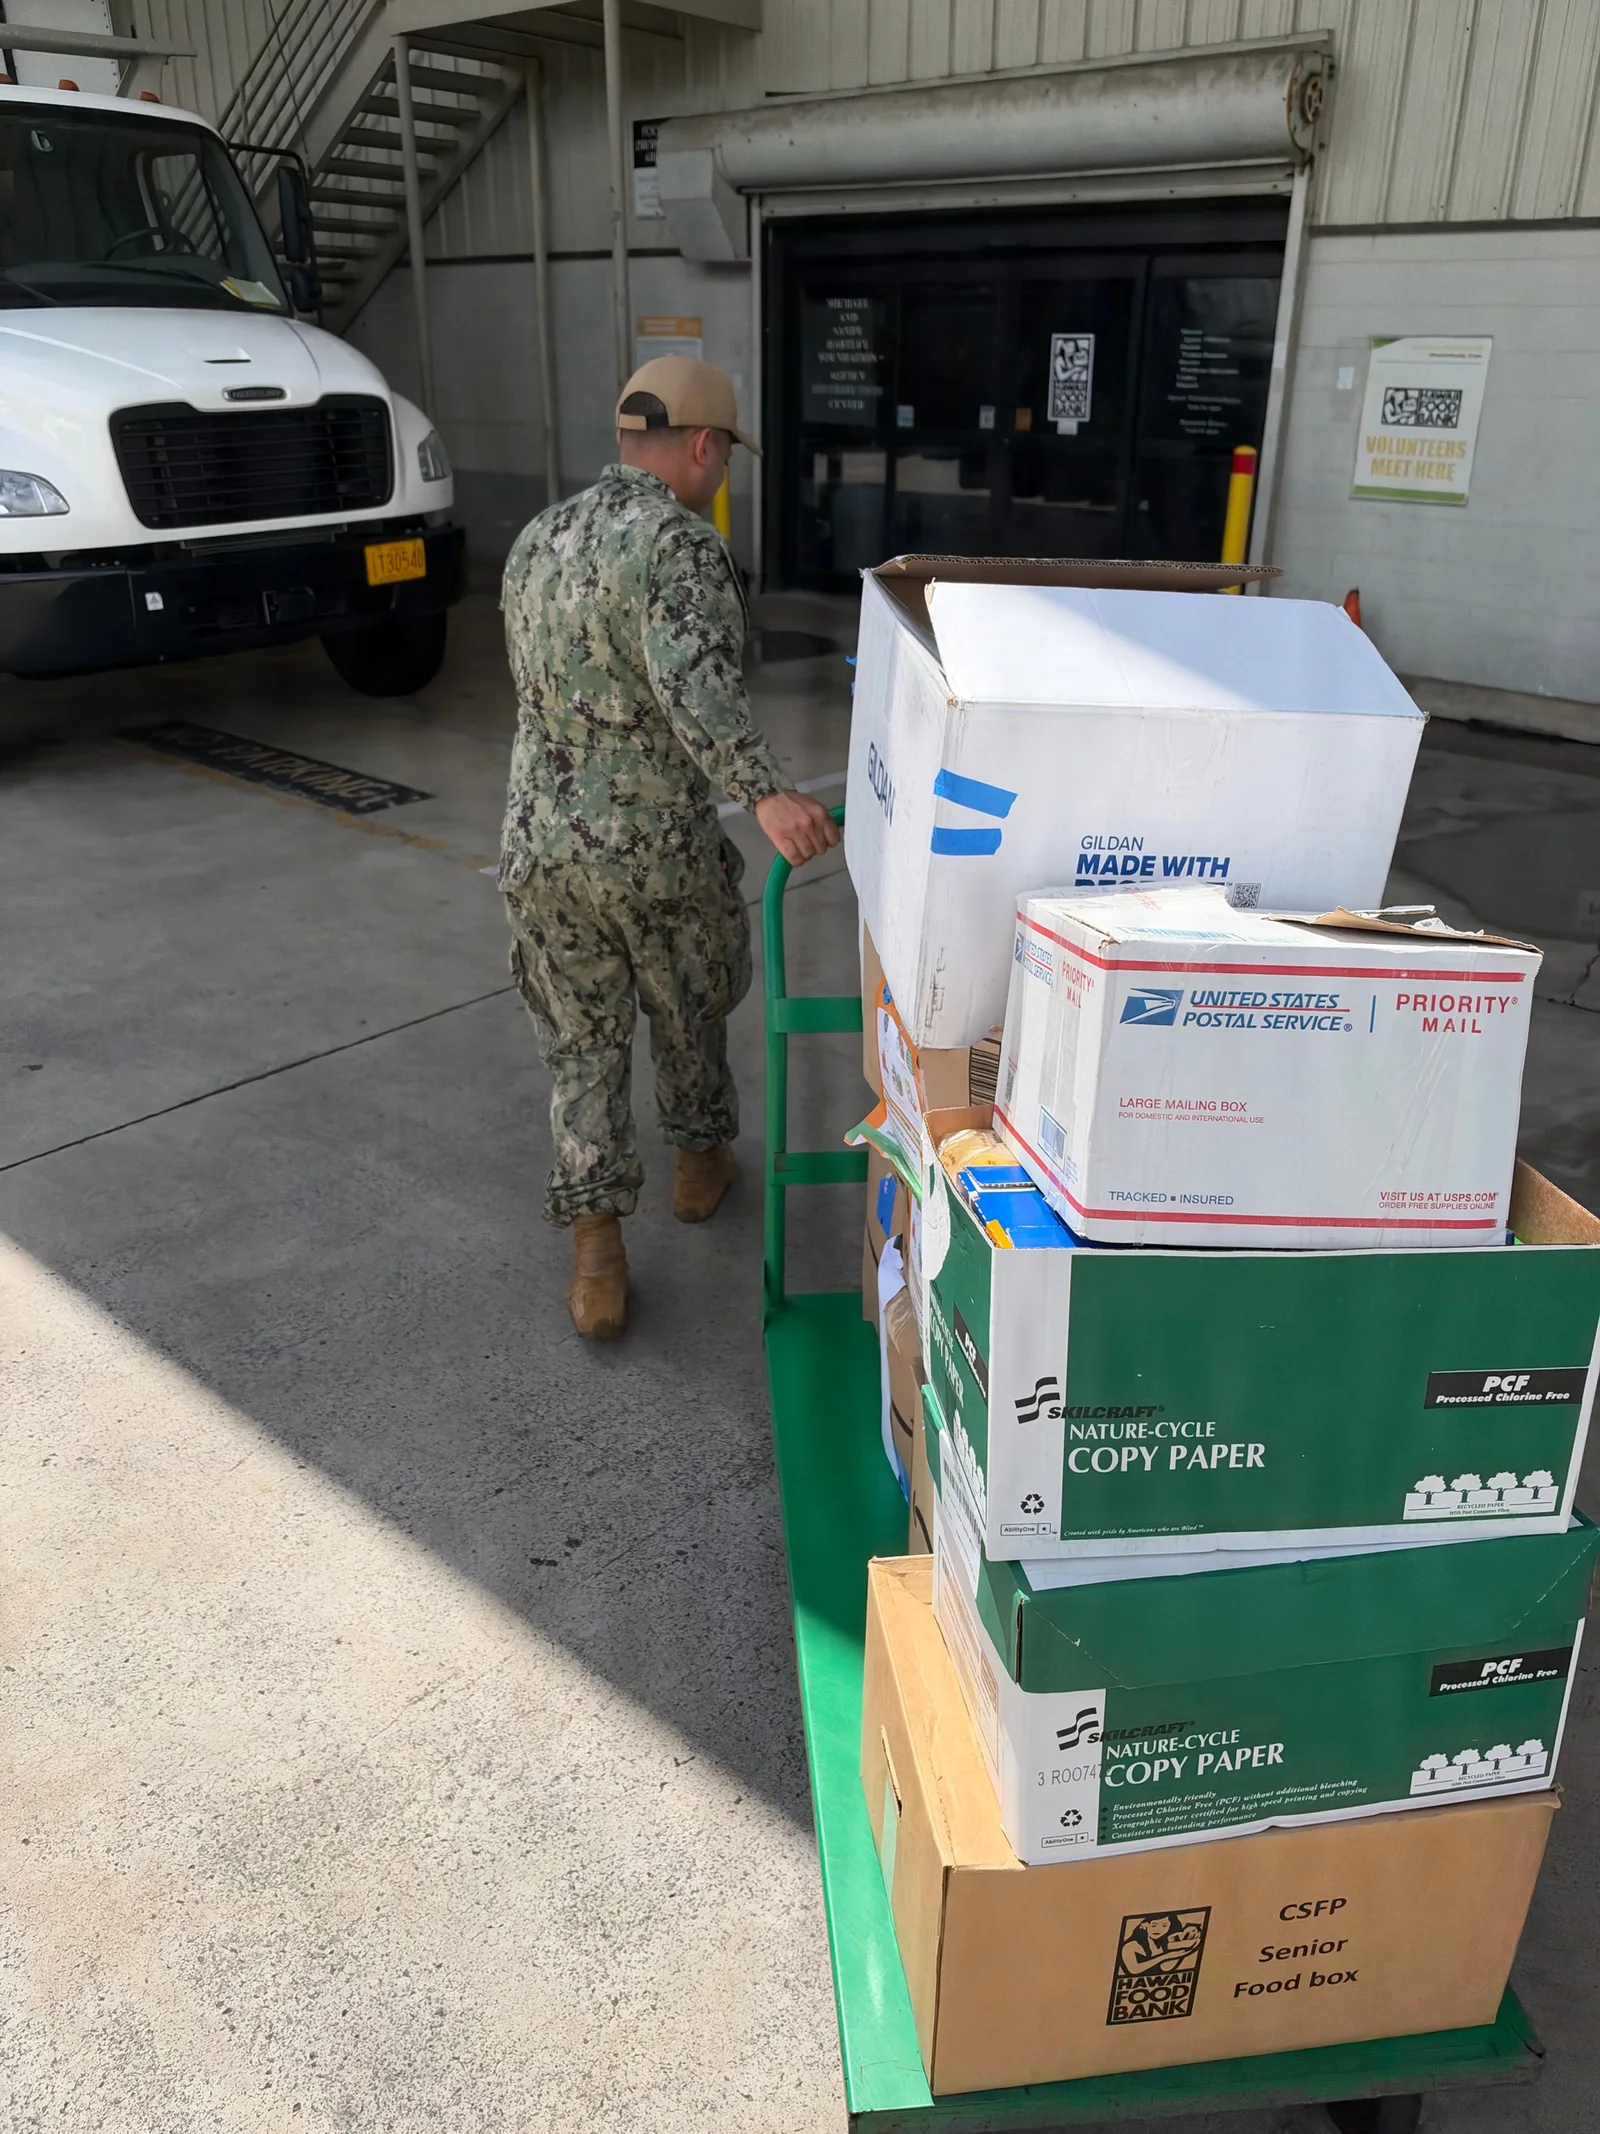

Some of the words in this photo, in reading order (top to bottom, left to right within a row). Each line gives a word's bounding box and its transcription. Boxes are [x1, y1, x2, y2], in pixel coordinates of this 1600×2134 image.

[1420, 400, 1458, 413] FOOD
[1418, 412, 1455, 426] BANK
[1366, 435, 1468, 460] VOLUNTEERS
[1371, 458, 1412, 479] MEET
[1416, 461, 1456, 482] HERE
[1081, 835, 1144, 851] GILDAN
[1076, 854, 1157, 876] MADE
[1162, 856, 1231, 877] WITH
[1066, 986, 1081, 1009] MAIL
[1189, 990, 1270, 1007] UNITED
[1270, 993, 1341, 1009] STATES
[1182, 1012, 1257, 1028] POSTAL
[1422, 1017, 1482, 1034] MAIL
[1119, 1098, 1161, 1109] LARGE
[1165, 1099, 1217, 1111] MAILING
[1220, 1101, 1248, 1112] BOX
[1118, 1111, 1134, 1119] FOR
[1135, 1112, 1173, 1121] DOMESTIC
[1174, 1113, 1190, 1121] AND
[1191, 1114, 1248, 1123] INTERNATIONAL
[1249, 1116, 1265, 1124] USE
[1109, 1191, 1167, 1203] TRACKED
[1179, 1194, 1234, 1206] INSURED
[1378, 1201, 1407, 1209] ORDER
[1408, 1202, 1429, 1210] FREE
[1430, 1202, 1468, 1210] SUPPLIES
[1469, 1202, 1495, 1210] ONLINE
[1380, 1191, 1407, 1201] VISIT
[1410, 1192, 1424, 1201] US
[1426, 1192, 1441, 1201] AT
[1482, 1375, 1531, 1393] PCF
[1435, 1393, 1492, 1404] Processed
[1495, 1391, 1542, 1402] Chlorine
[1545, 1391, 1570, 1400] Free
[1069, 1421, 1216, 1440] NATURE-CYCLE
[1067, 1446, 1159, 1474] COPY
[1169, 1443, 1266, 1470] PAPER
[1102, 1528, 1117, 1537] pride
[1118, 1527, 1126, 1535] by
[1481, 1657, 1523, 1677] PCF
[1439, 1677, 1490, 1692] Processed
[1491, 1673, 1533, 1684] Chlorine
[1536, 1668, 1558, 1678] Free
[1106, 1729, 1240, 1760] NATURE-CYCLE
[1104, 1755, 1189, 1788] COPY
[1197, 1742, 1285, 1776] PAPER
[1037, 1771, 1045, 1787] 3
[1112, 1809, 1154, 1821] Processed
[1156, 1804, 1192, 1815] Chlorine
[1194, 1802, 1213, 1810] Free
[1215, 1796, 1242, 1806] (PCF)
[1243, 1791, 1274, 1801] without
[1276, 1785, 1318, 1796] additional
[1320, 1779, 1358, 1790] bleaching
[1112, 1818, 1162, 1830] Xerographic
[1164, 1815, 1188, 1825] paper
[1190, 1809, 1225, 1819] certified
[1226, 1806, 1239, 1814] for
[1241, 1800, 1258, 1810] high
[1260, 1797, 1282, 1807] speed
[1284, 1793, 1318, 1804] printing
[1319, 1791, 1335, 1799] and
[1337, 1786, 1368, 1797] copying
[1113, 1795, 1182, 1812] Environmentally
[1183, 1791, 1217, 1803] friendly
[1111, 1828, 1154, 1840] Consistent
[1157, 1822, 1206, 1834] outstanding
[1207, 1812, 1257, 1827] performance
[1279, 1897, 1347, 1922] CSFP
[1258, 1938, 1349, 1963] Senior
[1117, 1971, 1193, 1991] HAWAII
[1233, 1973, 1301, 1998] Food
[1309, 1969, 1359, 1988] box
[1115, 1985, 1189, 2006] FOOD
[1112, 1999, 1187, 2021] BANK
